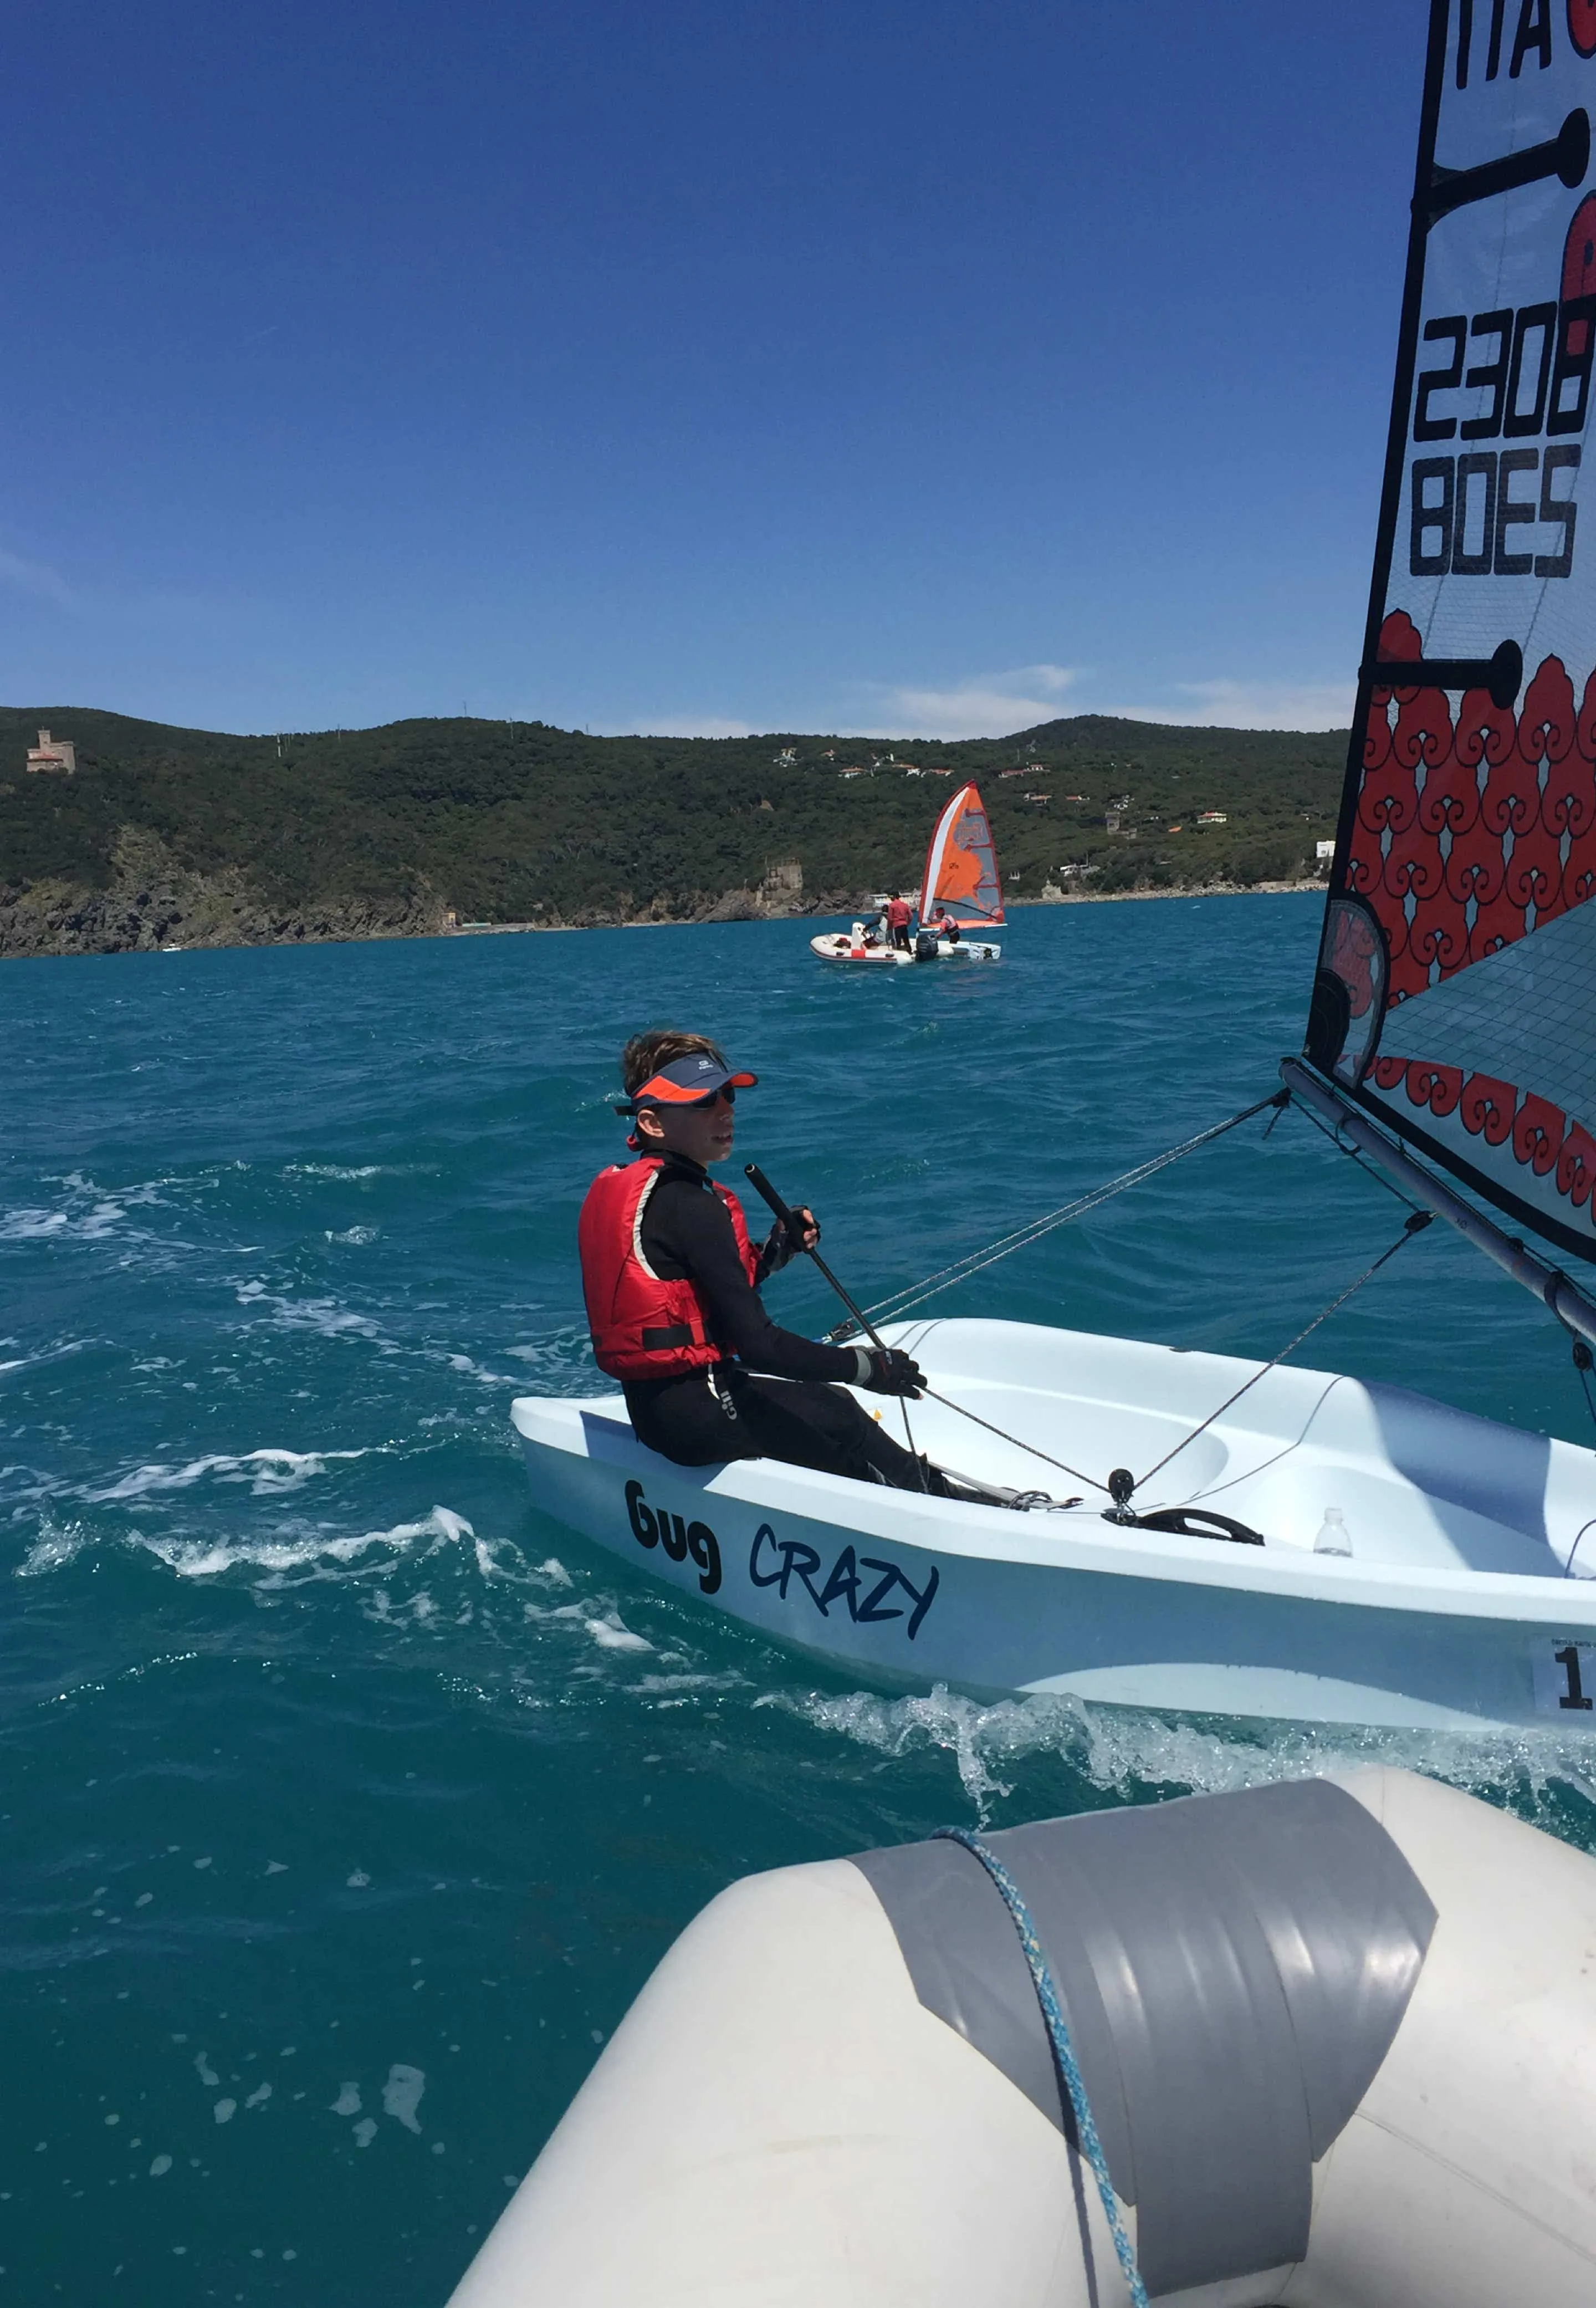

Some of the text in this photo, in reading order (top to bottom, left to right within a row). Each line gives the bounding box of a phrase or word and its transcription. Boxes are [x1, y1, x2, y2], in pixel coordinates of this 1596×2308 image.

[1413, 294, 1596, 442] 2308
[750, 1523, 939, 1641] CRAZY
[1554, 1647, 1593, 1710] 1
